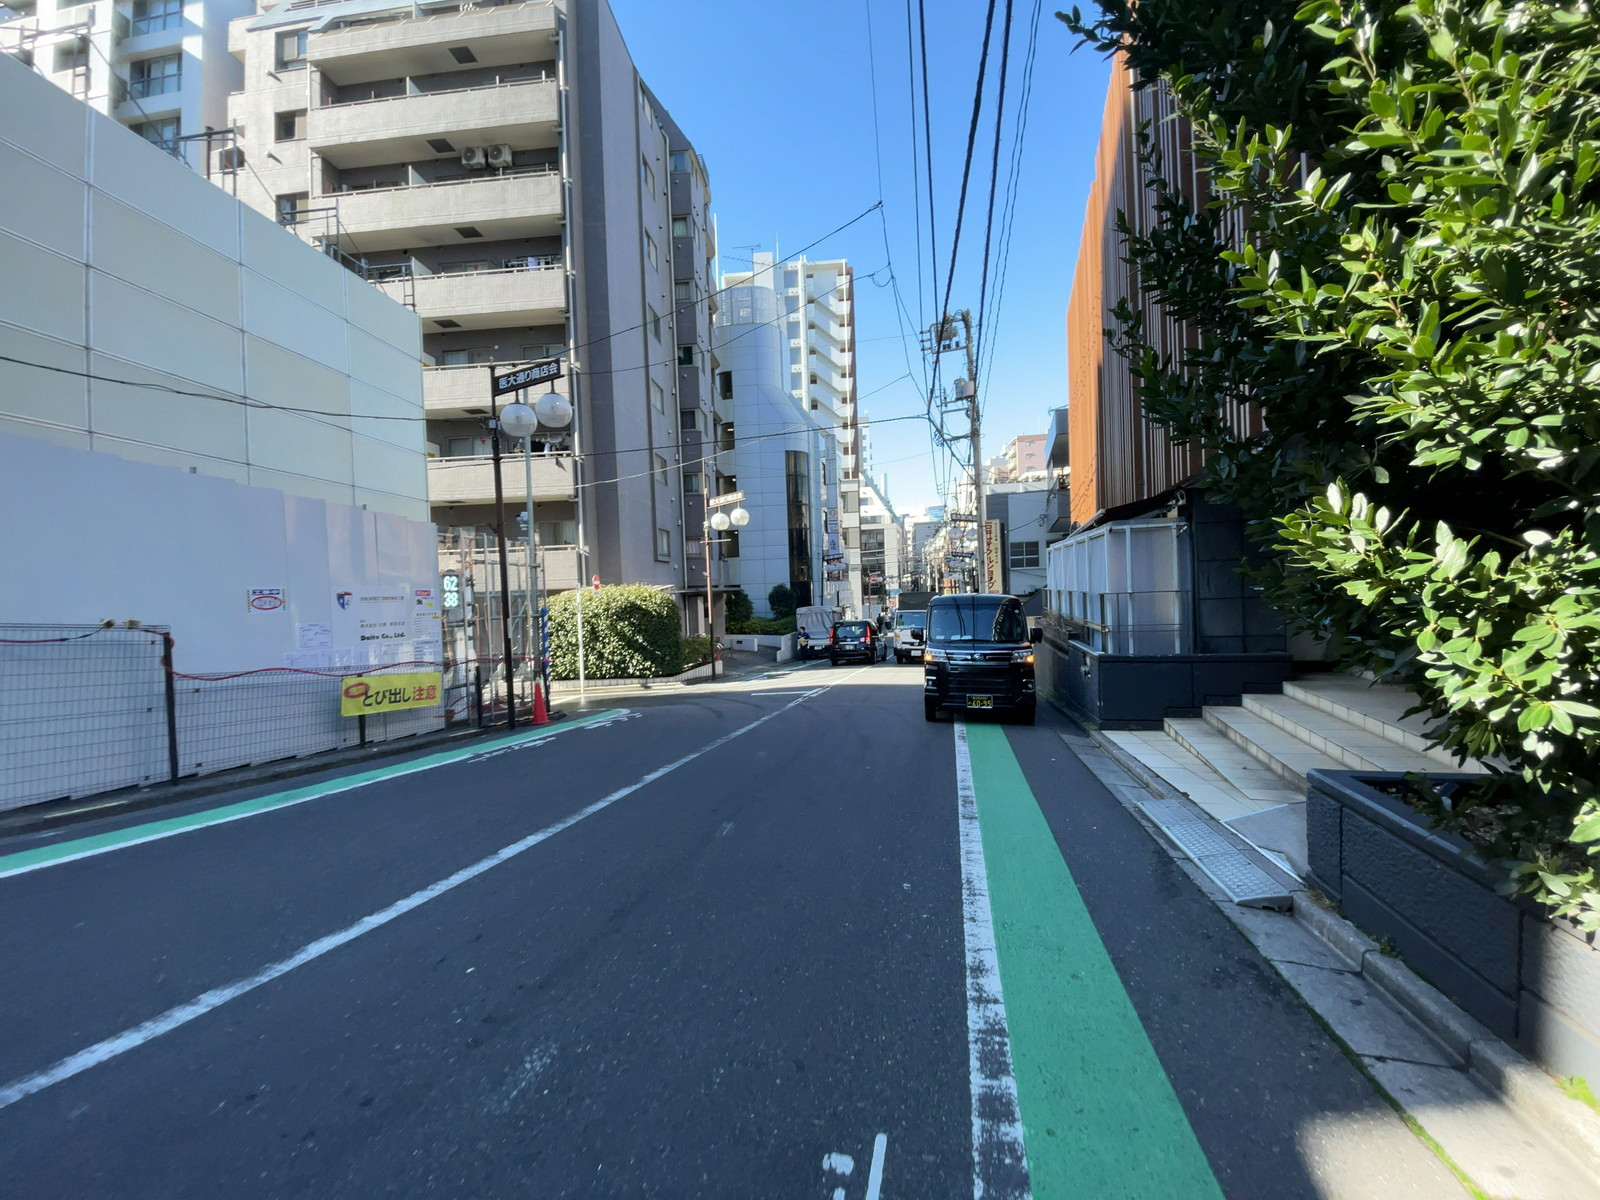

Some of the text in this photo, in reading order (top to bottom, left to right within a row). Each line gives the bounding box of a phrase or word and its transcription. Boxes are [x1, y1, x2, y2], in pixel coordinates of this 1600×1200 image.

[499, 363, 558, 389] 医大通り商店会
[443, 576, 458, 591] 62
[443, 592, 458, 608] 38
[363, 685, 437, 707] とび出し注意
